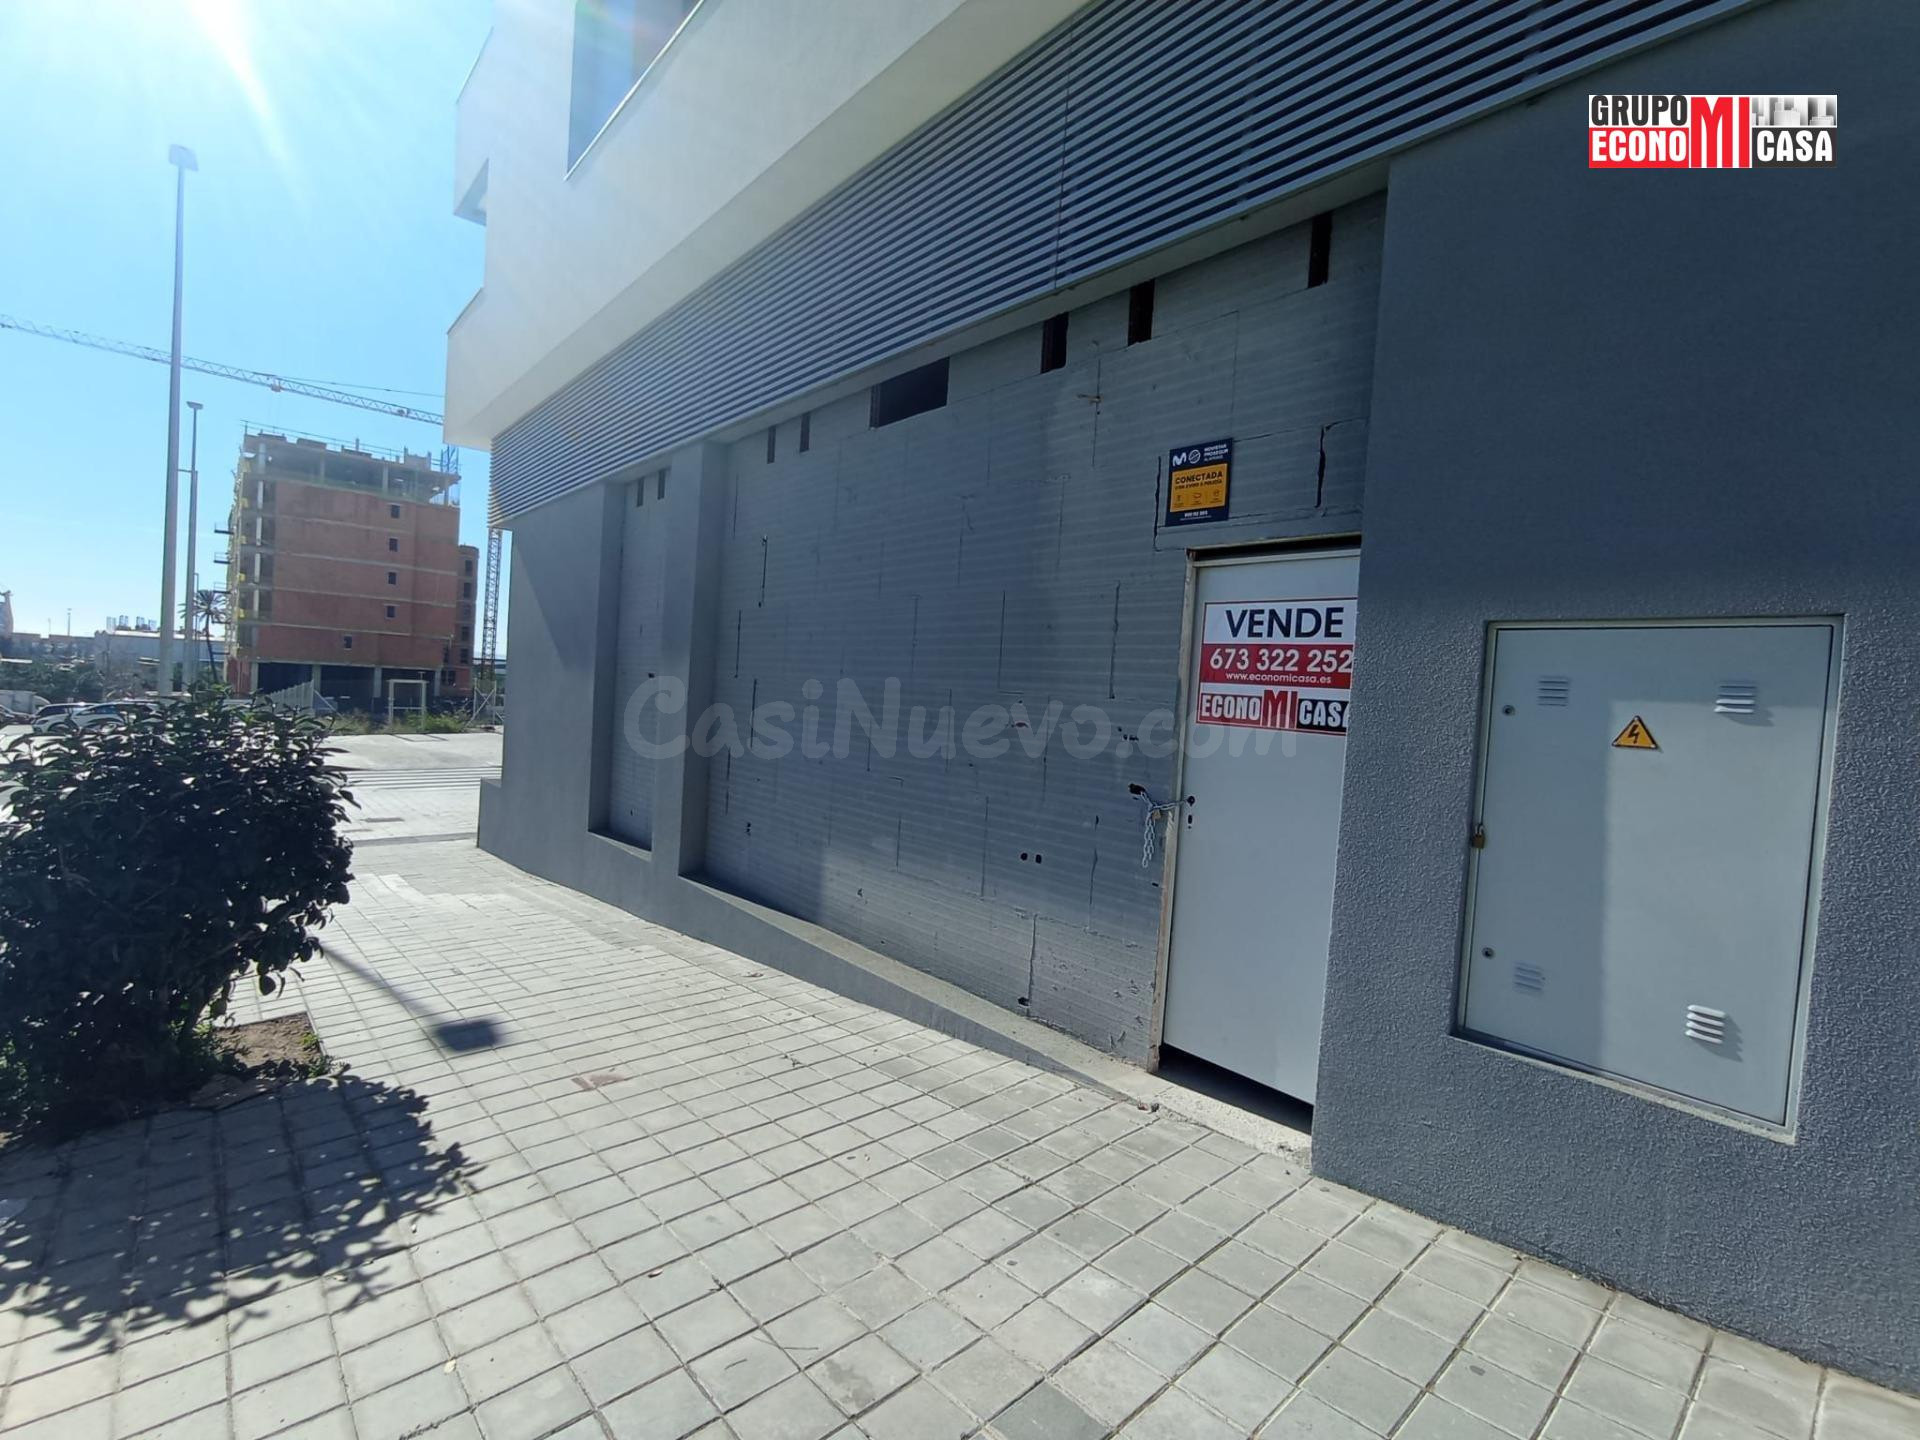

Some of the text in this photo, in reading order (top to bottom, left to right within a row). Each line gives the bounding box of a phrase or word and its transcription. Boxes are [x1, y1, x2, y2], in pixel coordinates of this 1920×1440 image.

[1175, 471, 1223, 484] CONECTADA
[1226, 607, 1345, 638] VENDE
[1210, 648, 1353, 673] 673 322 252
[1226, 673, 1332, 684] www.economicasa.es
